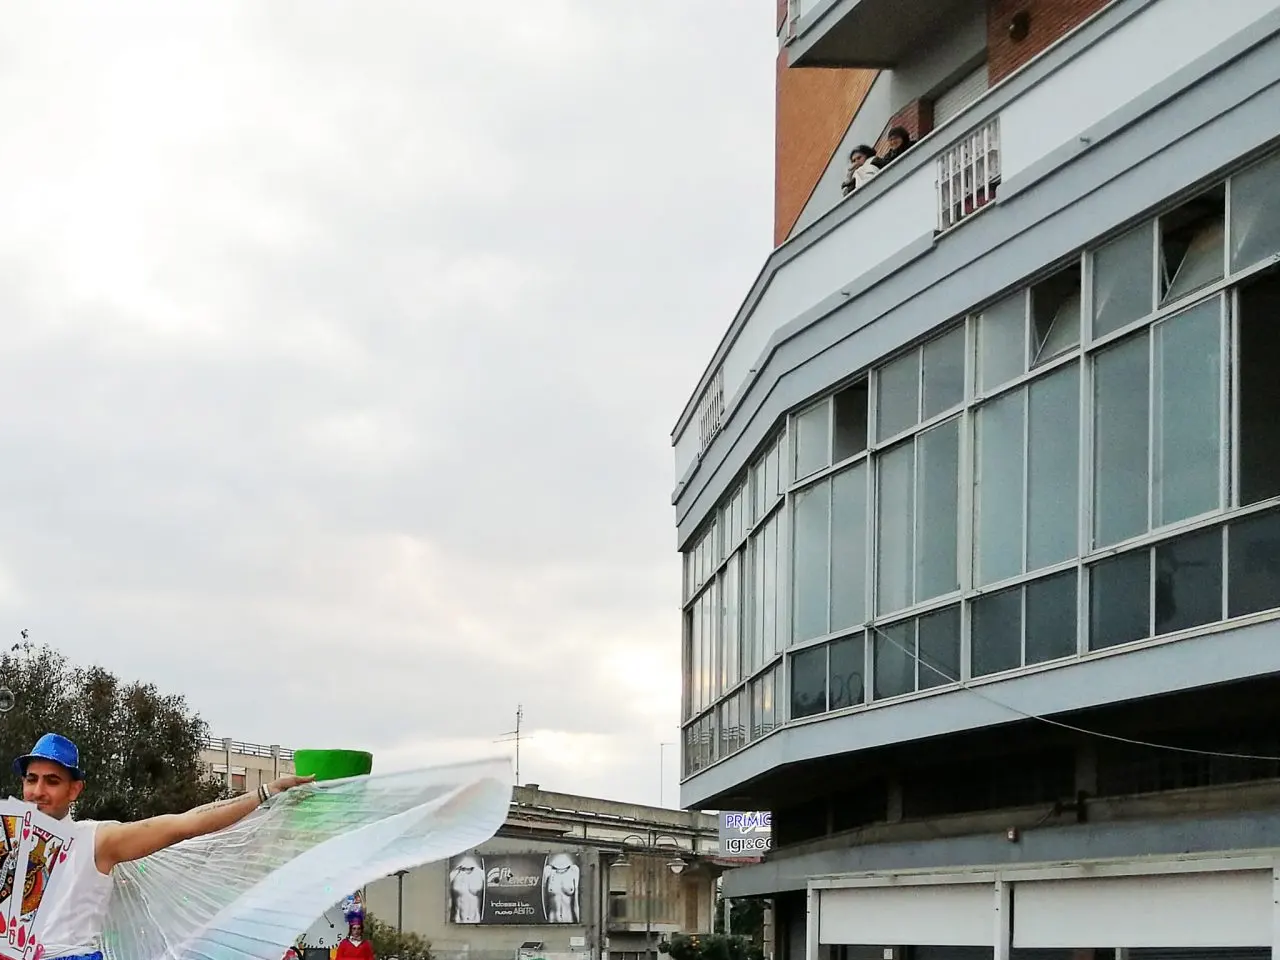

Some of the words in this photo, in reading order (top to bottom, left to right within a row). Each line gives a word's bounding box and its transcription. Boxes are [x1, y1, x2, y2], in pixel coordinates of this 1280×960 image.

[24, 811, 31, 826] Q
[63, 837, 74, 851] J
[500, 868, 511, 879] fit
[509, 875, 539, 886] energy
[513, 907, 534, 915] ABITO
[22, 947, 32, 960] J
